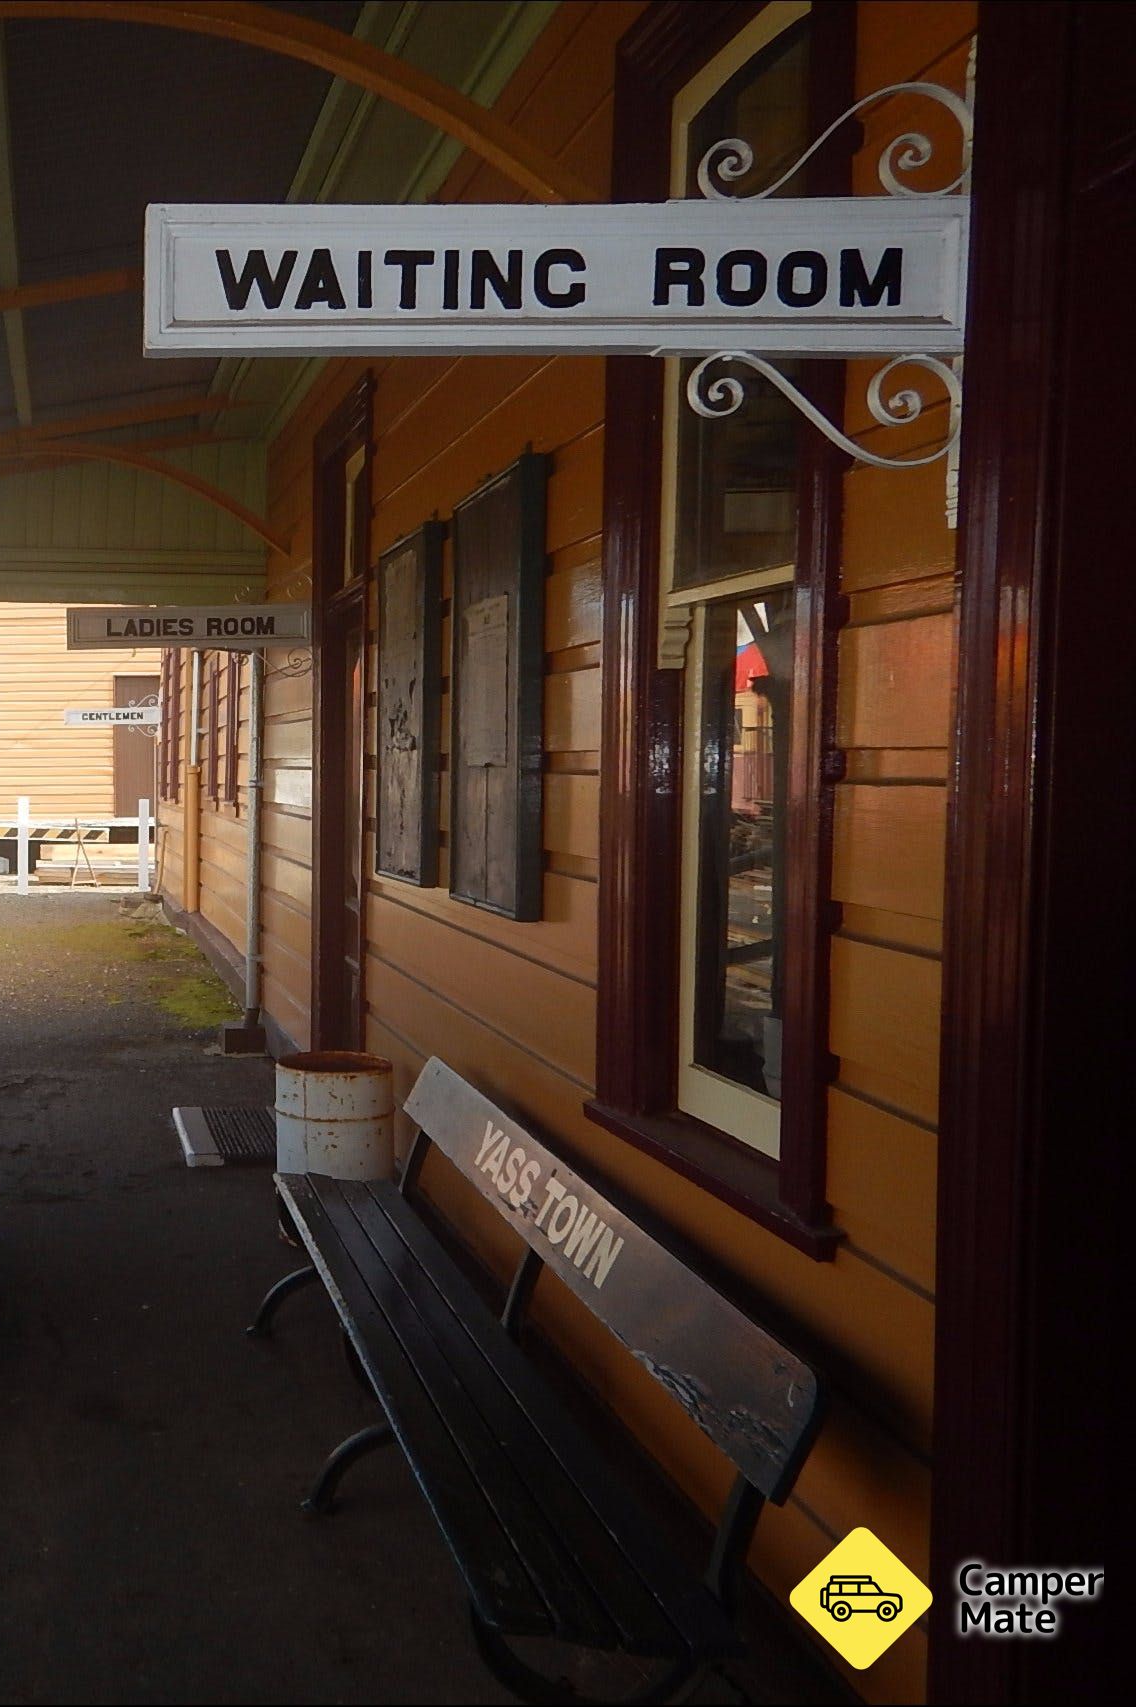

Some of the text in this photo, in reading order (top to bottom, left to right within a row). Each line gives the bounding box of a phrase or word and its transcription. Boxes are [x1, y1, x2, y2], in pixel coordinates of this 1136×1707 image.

[215, 247, 903, 311] WAITING ROOM
[106, 616, 275, 637] LADIES ROOM
[81, 711, 144, 721] GENTLEMEN
[473, 1120, 624, 1289] YASS TOWN
